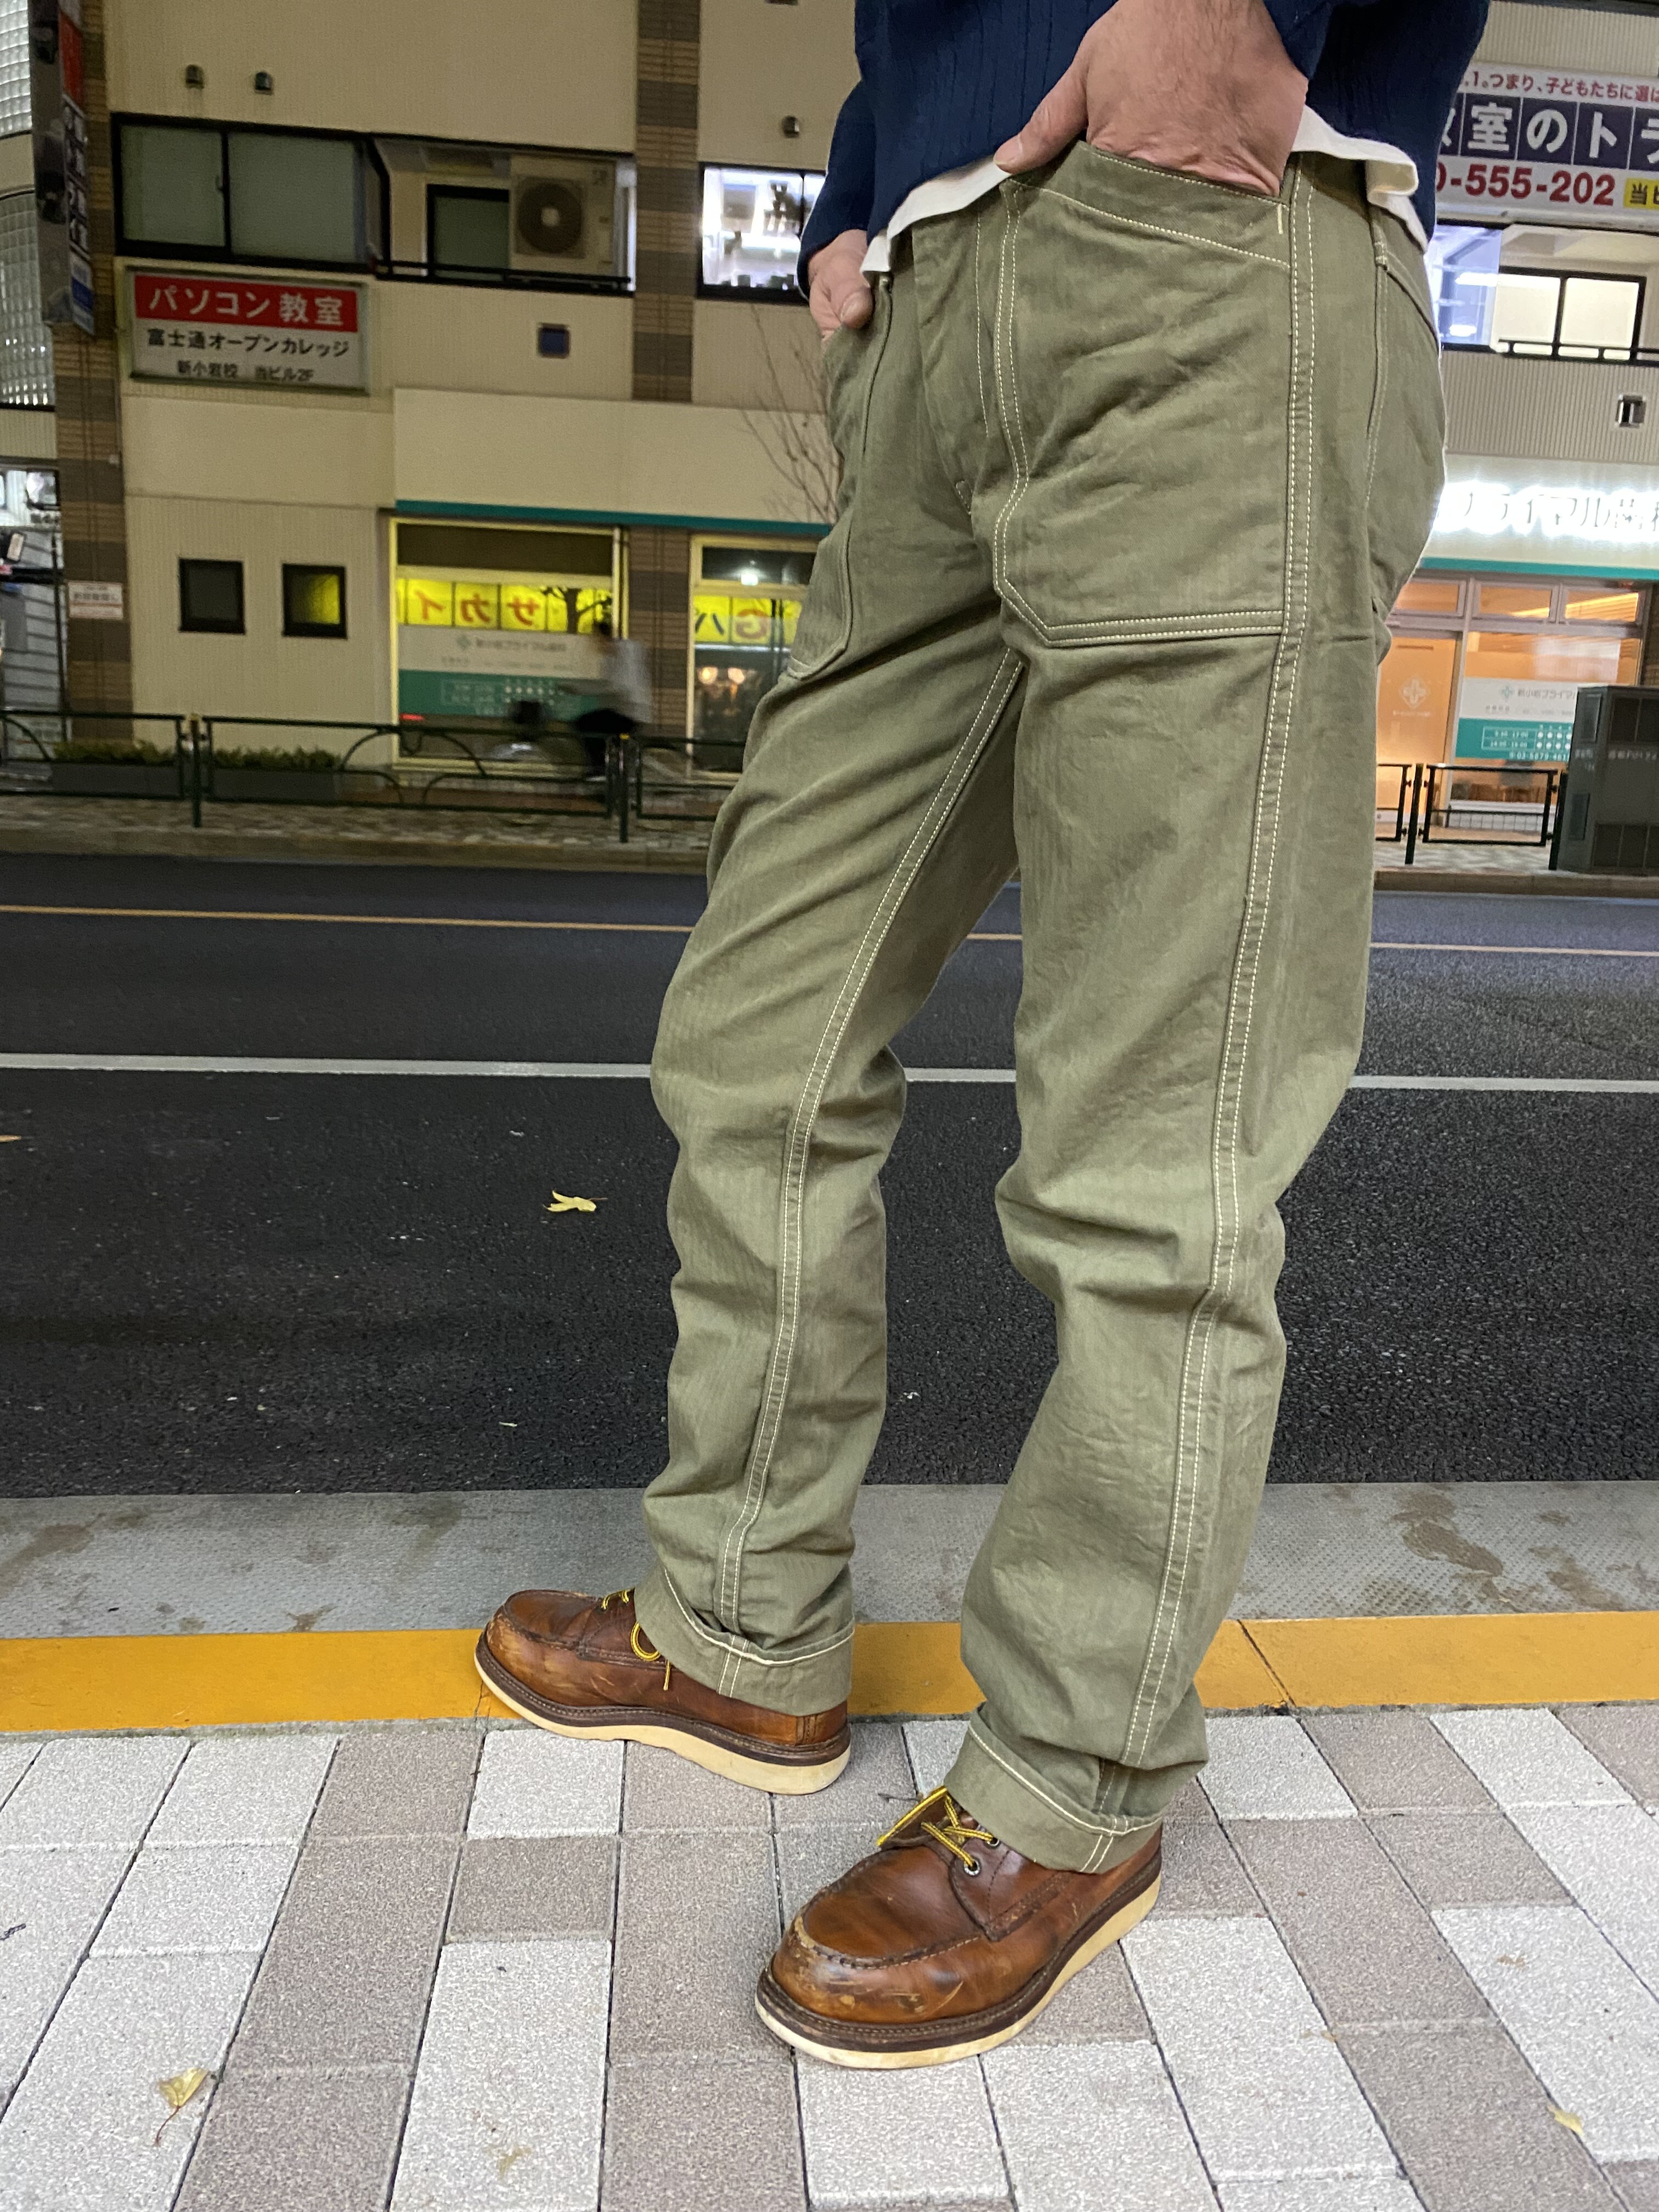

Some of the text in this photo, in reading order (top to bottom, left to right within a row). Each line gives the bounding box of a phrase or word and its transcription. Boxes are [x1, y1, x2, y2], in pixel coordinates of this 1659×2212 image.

[1441, 102, 1659, 163] 室のト
[149, 284, 343, 326] パソコン教室
[148, 328, 349, 358] 富士通オープンカレッジ
